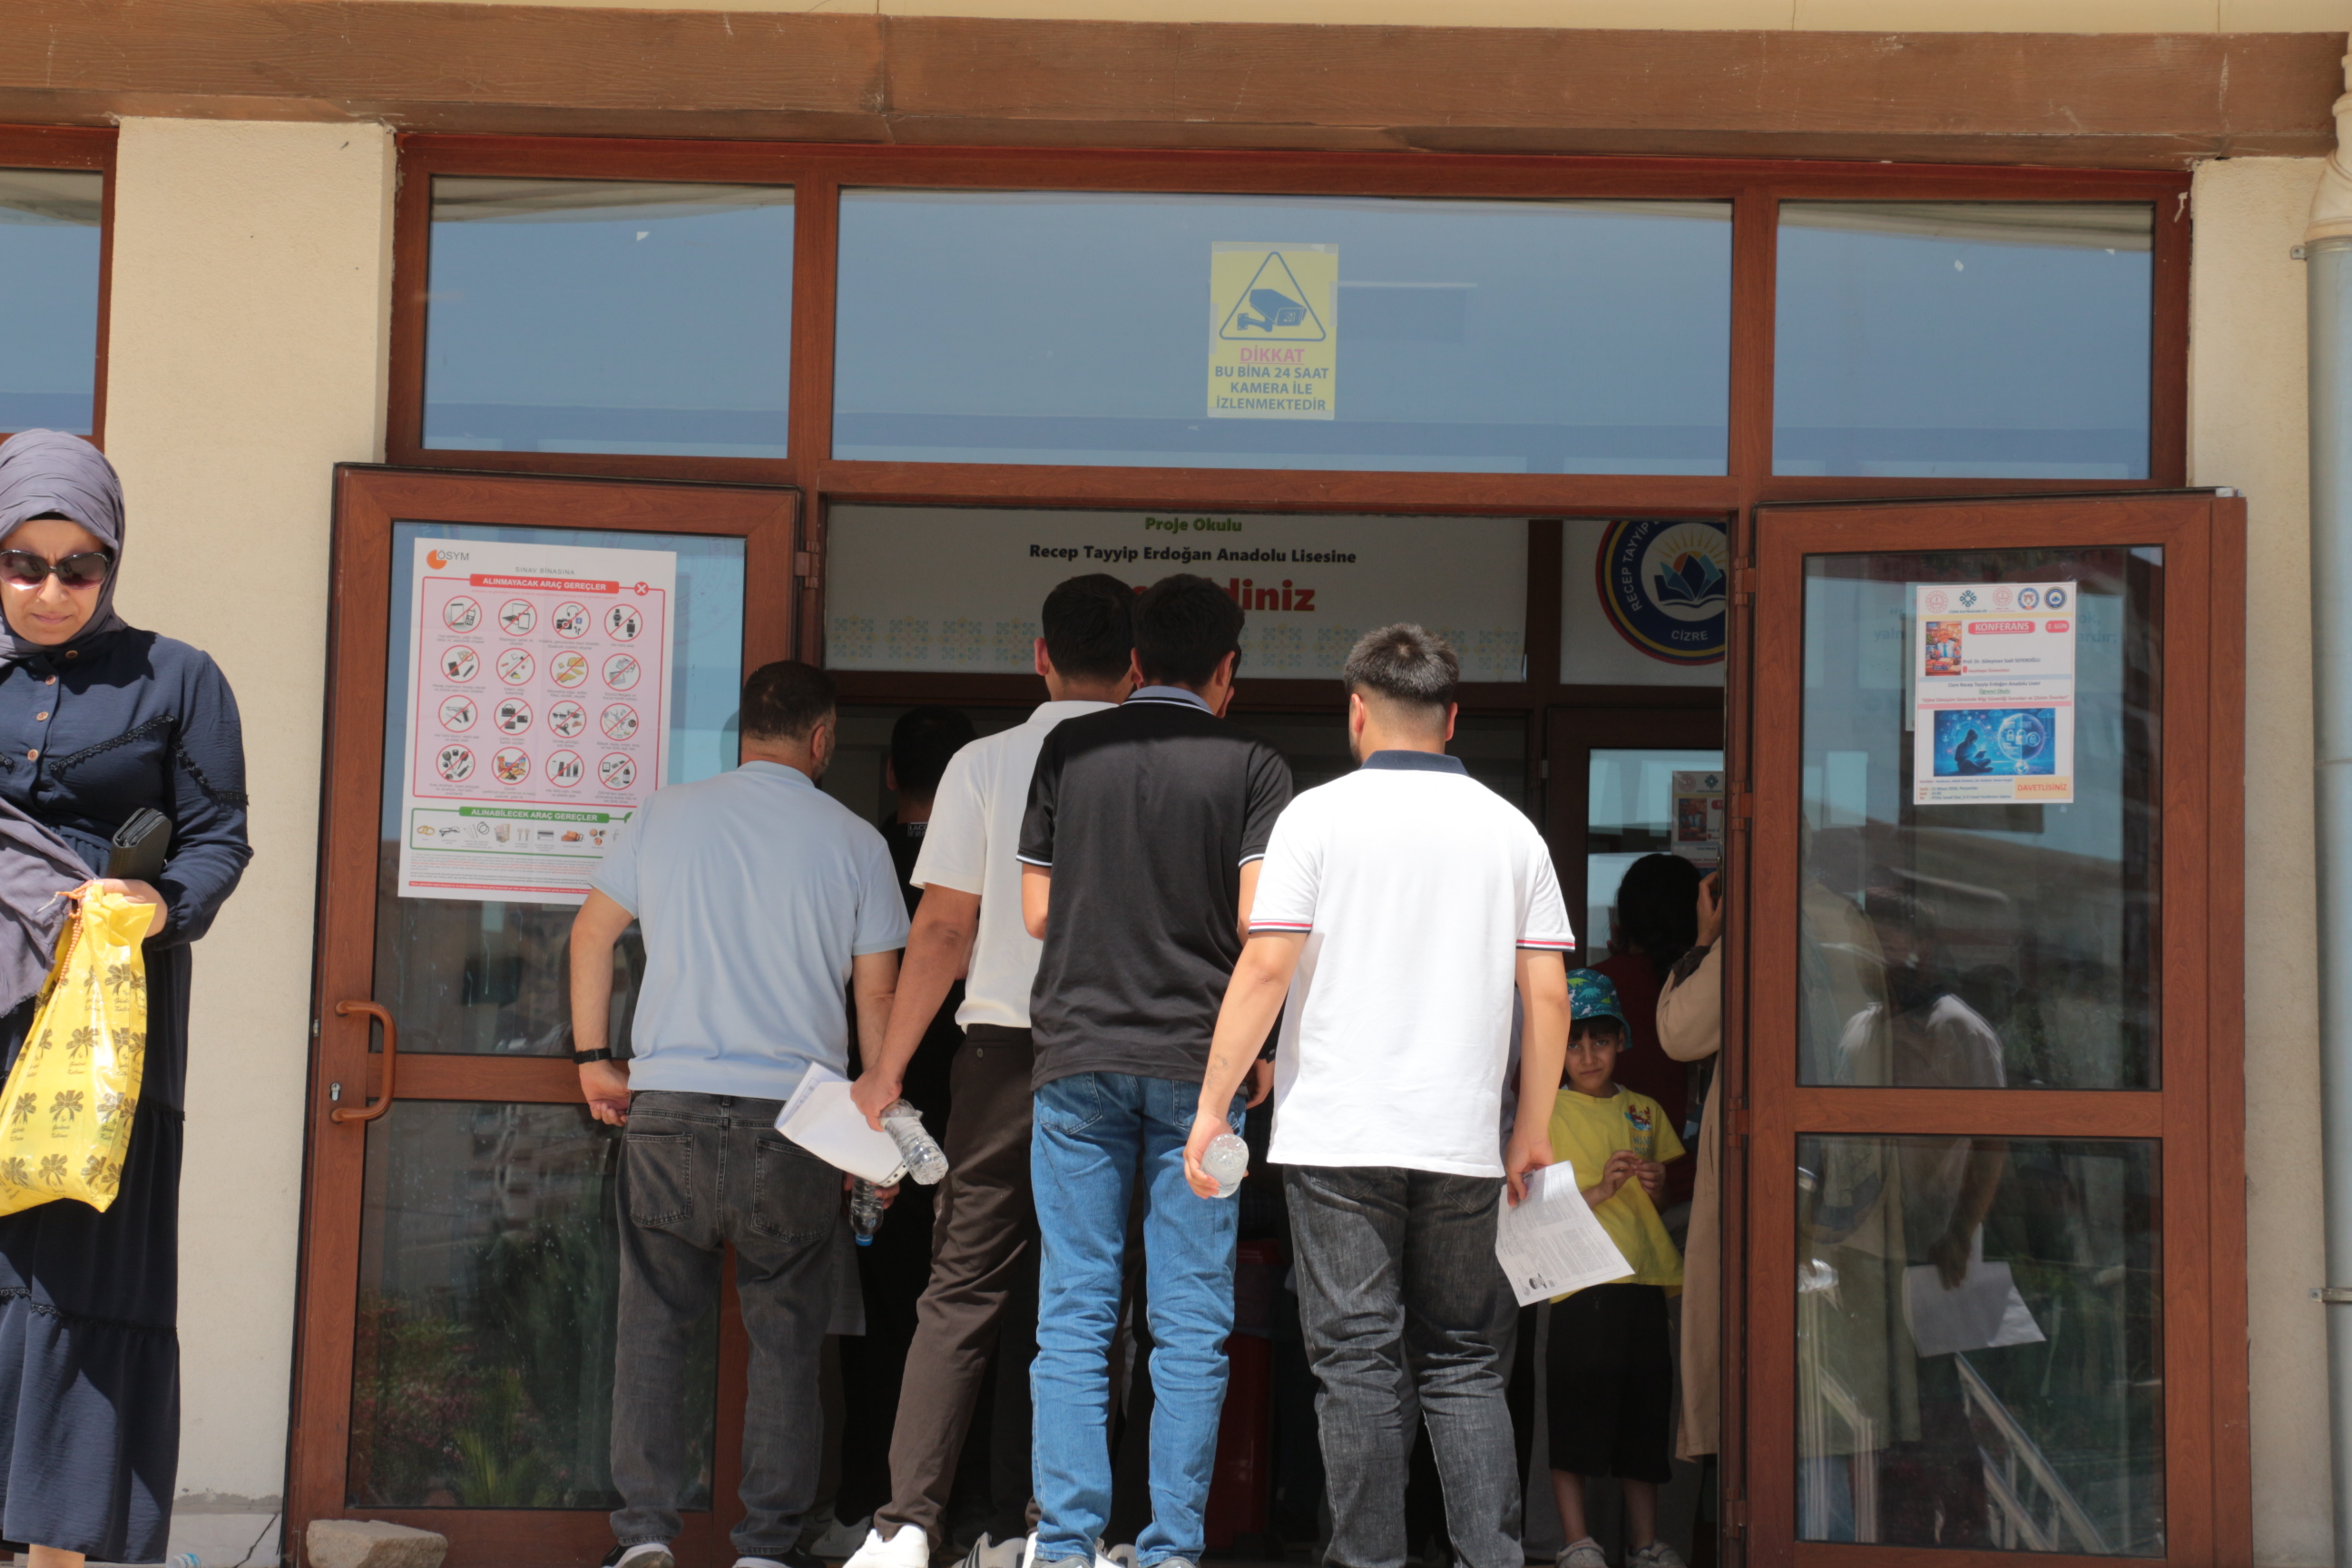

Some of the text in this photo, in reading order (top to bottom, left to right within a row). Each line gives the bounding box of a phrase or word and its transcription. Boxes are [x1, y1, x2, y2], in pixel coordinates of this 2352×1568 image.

[1240, 345, 1305, 363] DİKKAT
[1215, 364, 1329, 379] BU BİNA 24 SAAT
[1230, 381, 1312, 395] KAMERA İLE
[1216, 396, 1326, 411] İZLENMEKTEDİR
[1144, 516, 1242, 534] Proje Okulu
[1622, 522, 1650, 562] TAYYİP
[437, 550, 470, 561] ÖSYM
[1029, 544, 1357, 564] Recep Tayyip Erdoğan Anadolu Lisesine
[482, 577, 607, 592] ALINMAYACAK ARAÇ GEREÇLER
[1622, 567, 1643, 612] RECEP
[1975, 622, 2030, 632] KONFERANS
[1671, 629, 1709, 641] CİZRE
[2017, 782, 2067, 791] DAVETLİSİNİZ
[471, 808, 598, 822] ALINABİLECEK ARAÇ GEREÇLER
